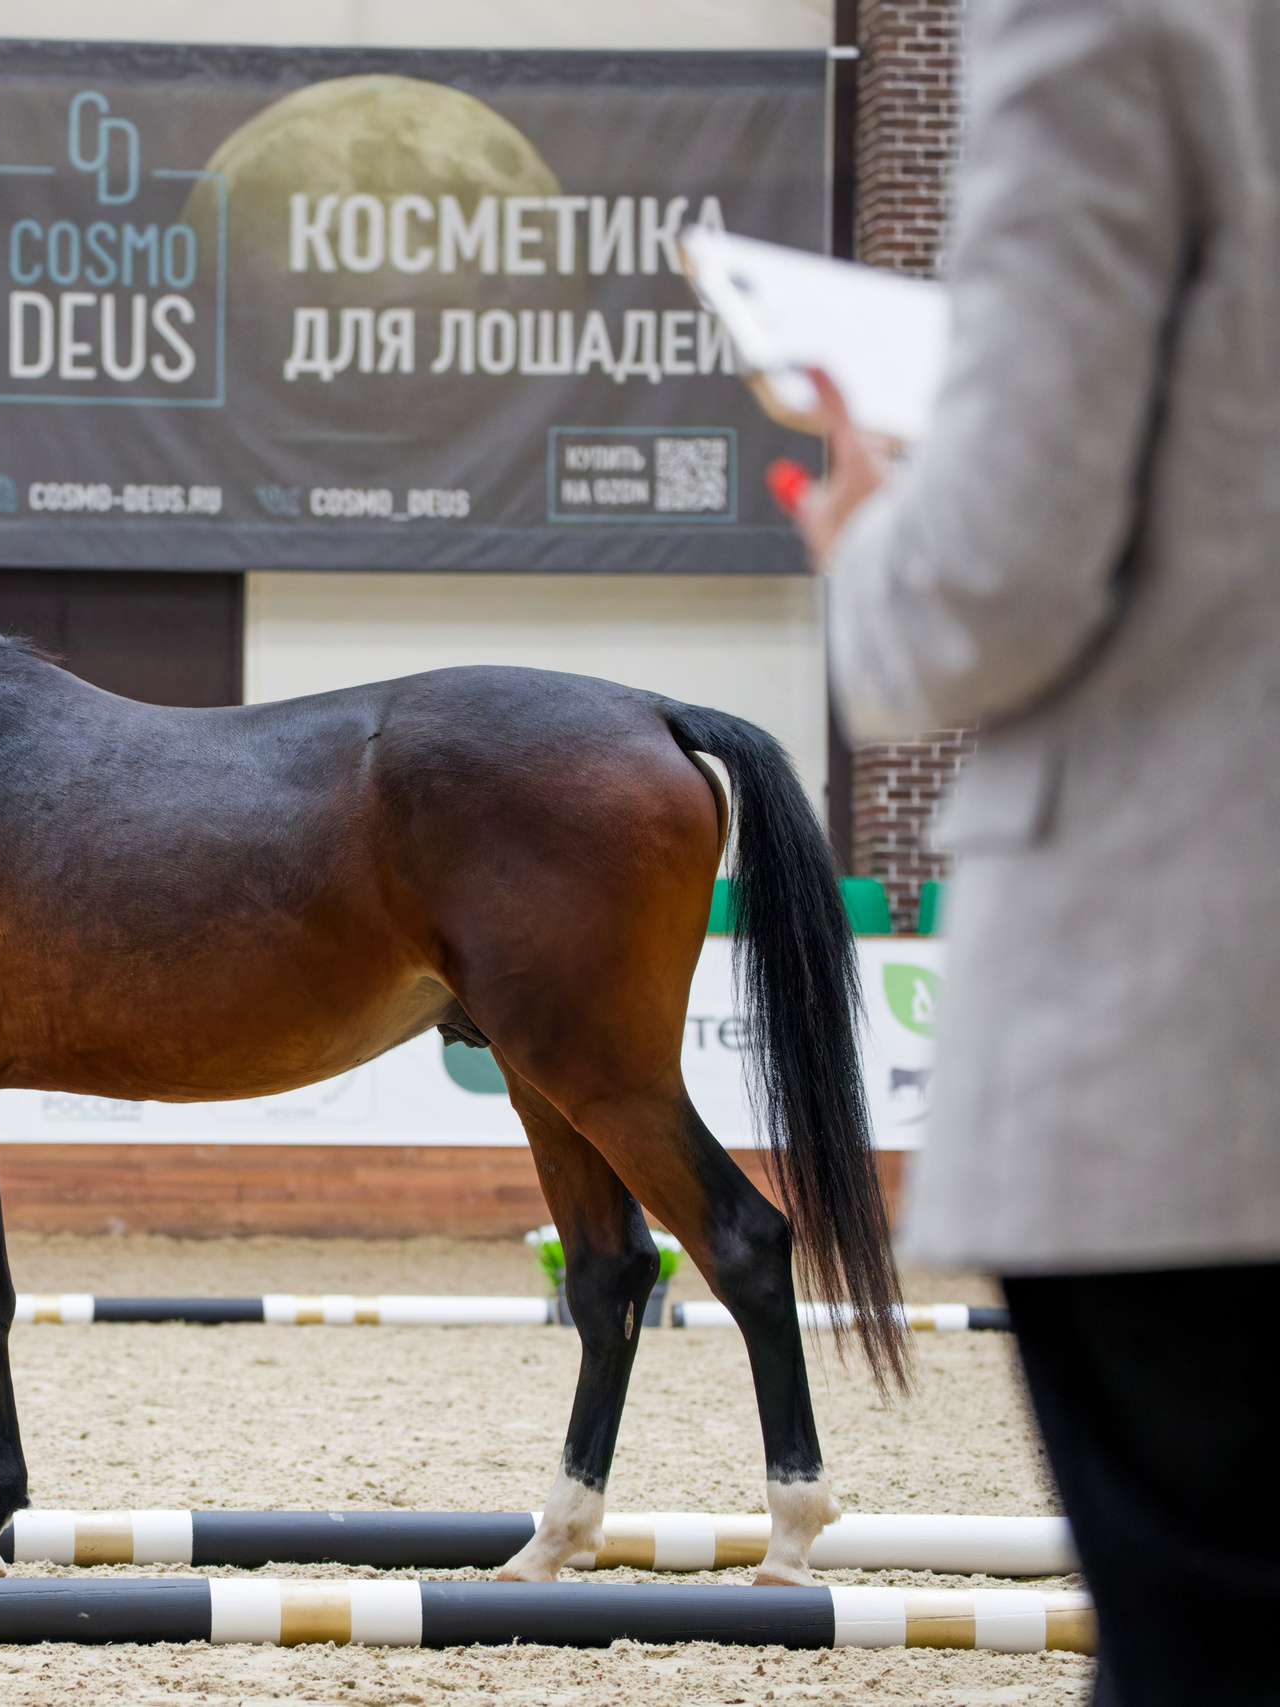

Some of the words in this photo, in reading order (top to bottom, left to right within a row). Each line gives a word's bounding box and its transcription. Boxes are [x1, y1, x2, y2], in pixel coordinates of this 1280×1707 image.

[9, 218, 197, 288] COSMO
[9, 290, 196, 383] DEUS
[283, 307, 416, 382] ДЛЯ
[565, 445, 646, 472] КУПИТЬ
[28, 482, 222, 515] COSMO-DEUS.RU
[310, 487, 470, 522] COSMO_DEUS
[561, 478, 593, 505] НА
